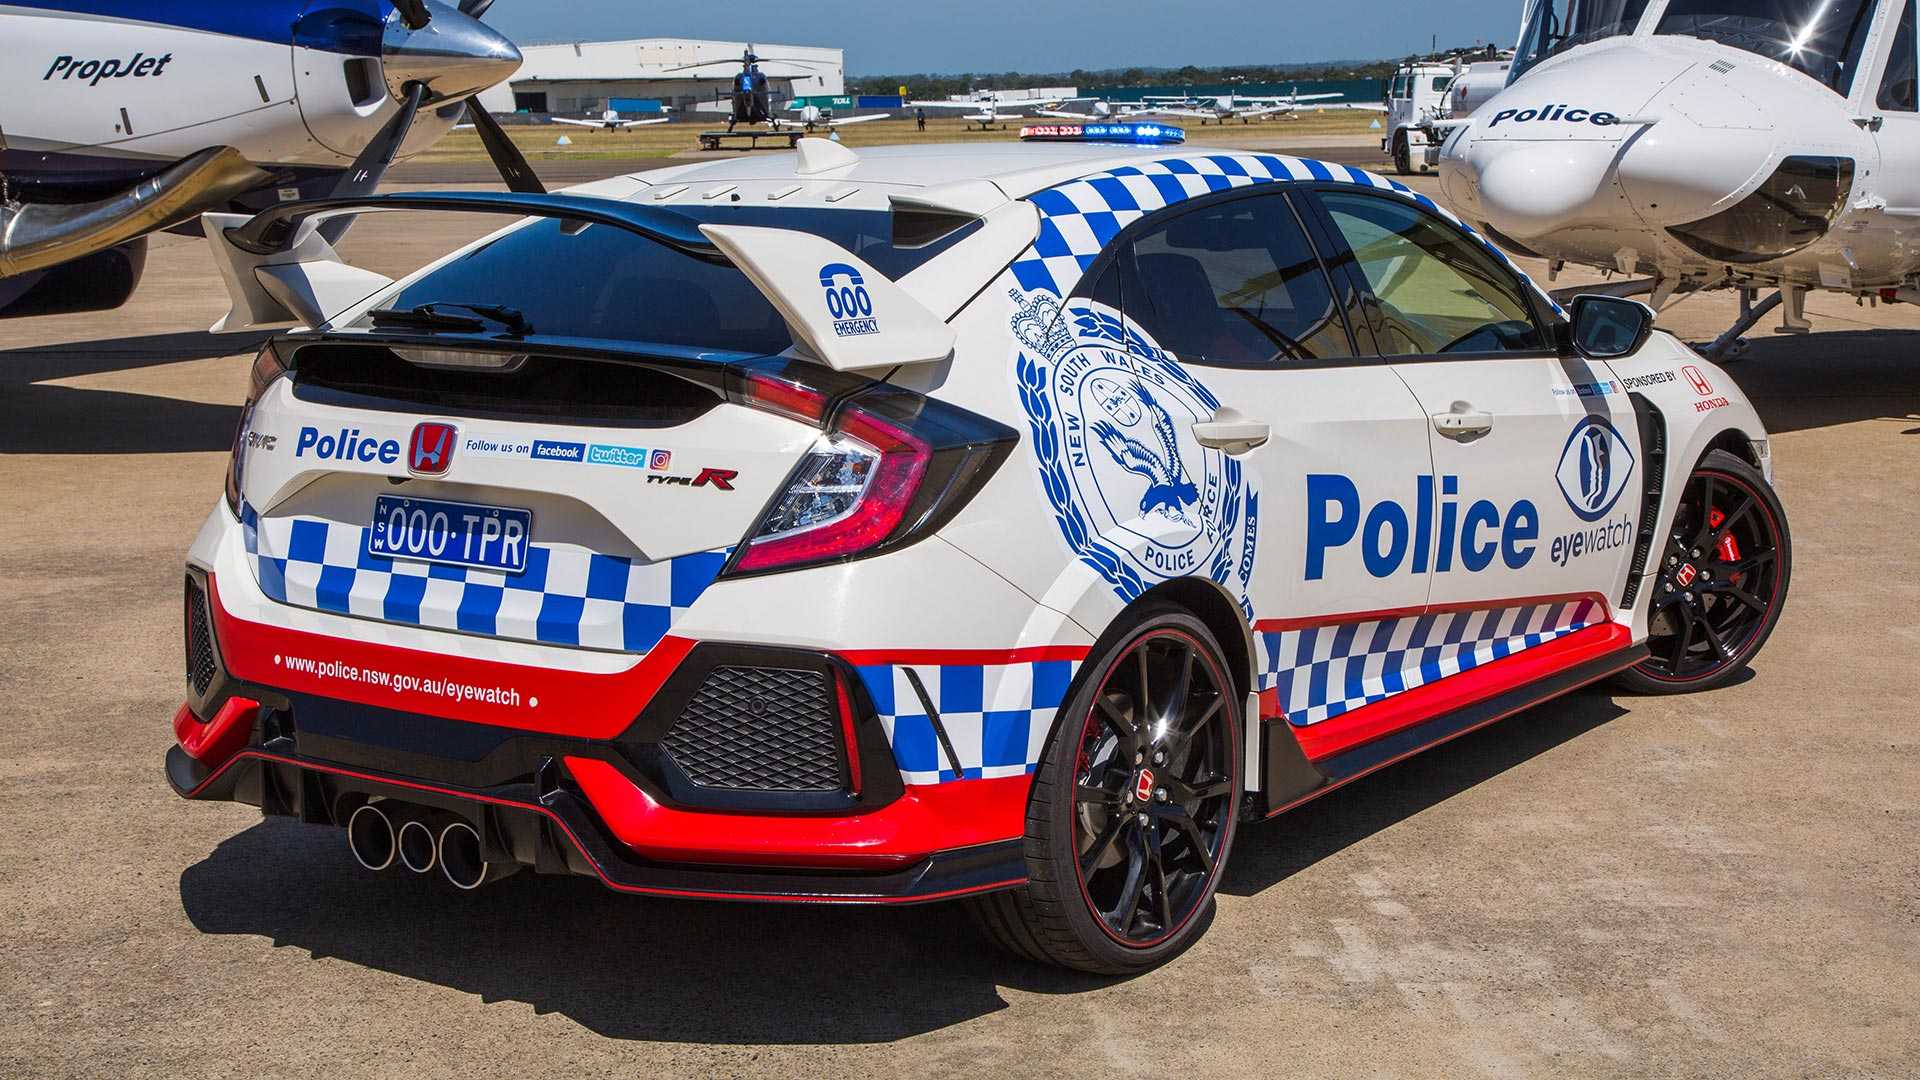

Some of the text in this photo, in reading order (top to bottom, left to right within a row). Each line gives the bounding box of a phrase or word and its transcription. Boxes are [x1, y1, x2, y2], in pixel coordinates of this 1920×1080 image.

[43, 52, 174, 87] PropJet
[832, 319, 880, 336] EMERGENCY
[1059, 352, 1092, 397] SOUTH
[1623, 372, 1667, 389] SPONSORED
[1666, 369, 1677, 383] BY
[1694, 396, 1730, 413] HONDA
[296, 426, 401, 465] Police
[466, 439, 643, 465] Follow us on facebook twitter
[1066, 411, 1086, 468] NEW
[646, 467, 739, 491] TYPE R
[1303, 473, 1540, 581] Police
[1550, 513, 1632, 567] eyewatch
[1144, 545, 1196, 571] POLICE
[285, 654, 521, 707] www.police.nsw.gov.au/eyewatch
